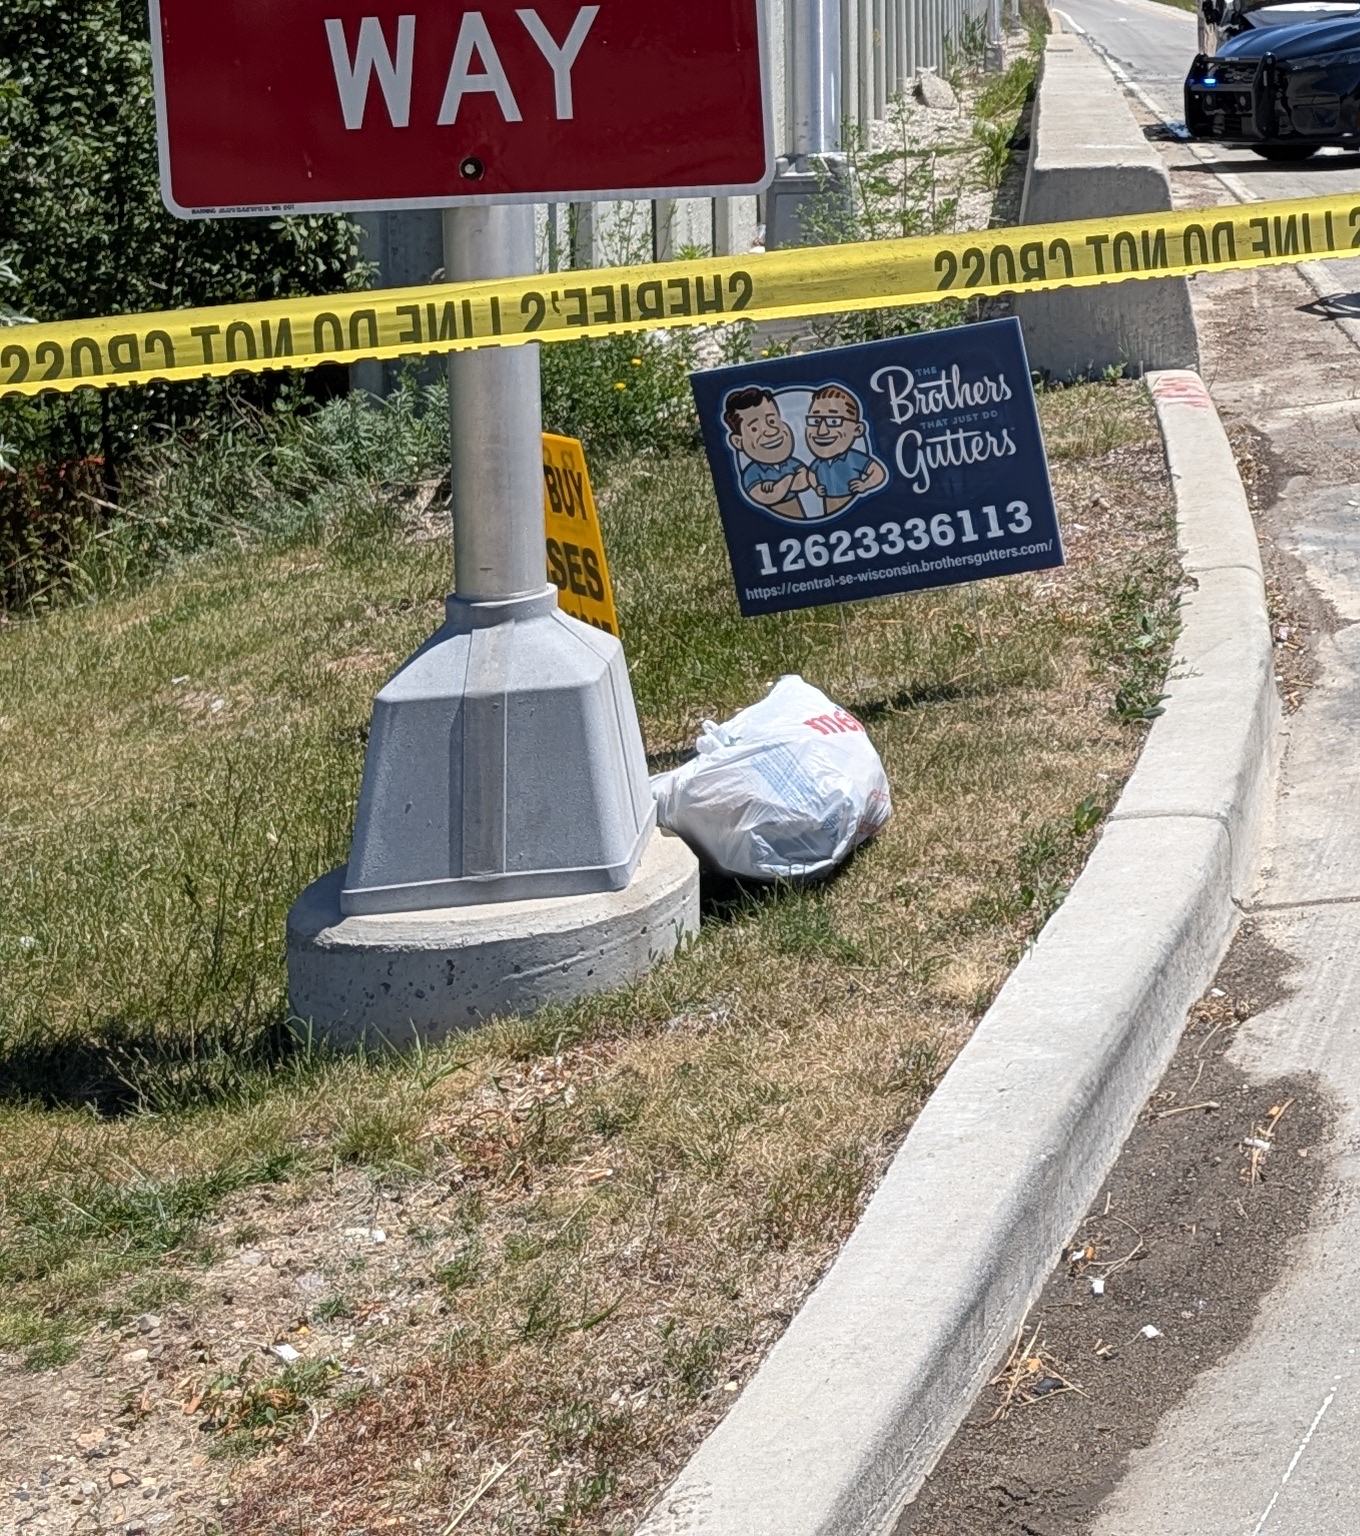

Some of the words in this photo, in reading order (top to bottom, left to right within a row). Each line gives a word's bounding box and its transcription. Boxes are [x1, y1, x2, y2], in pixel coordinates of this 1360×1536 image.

[324, 5, 600, 130] WAY
[870, 364, 1013, 425] Brothers
[915, 366, 938, 377] THE
[920, 417, 948, 430] THAT
[952, 413, 979, 425] JUST
[982, 409, 998, 420] DO
[895, 428, 1017, 494] Gutters
[543, 465, 587, 521] BUY
[755, 500, 1033, 576] 12623336113
[546, 537, 605, 603] SES
[745, 539, 1053, 600] https://central-se-wisconsin.brothersgutters.com/
